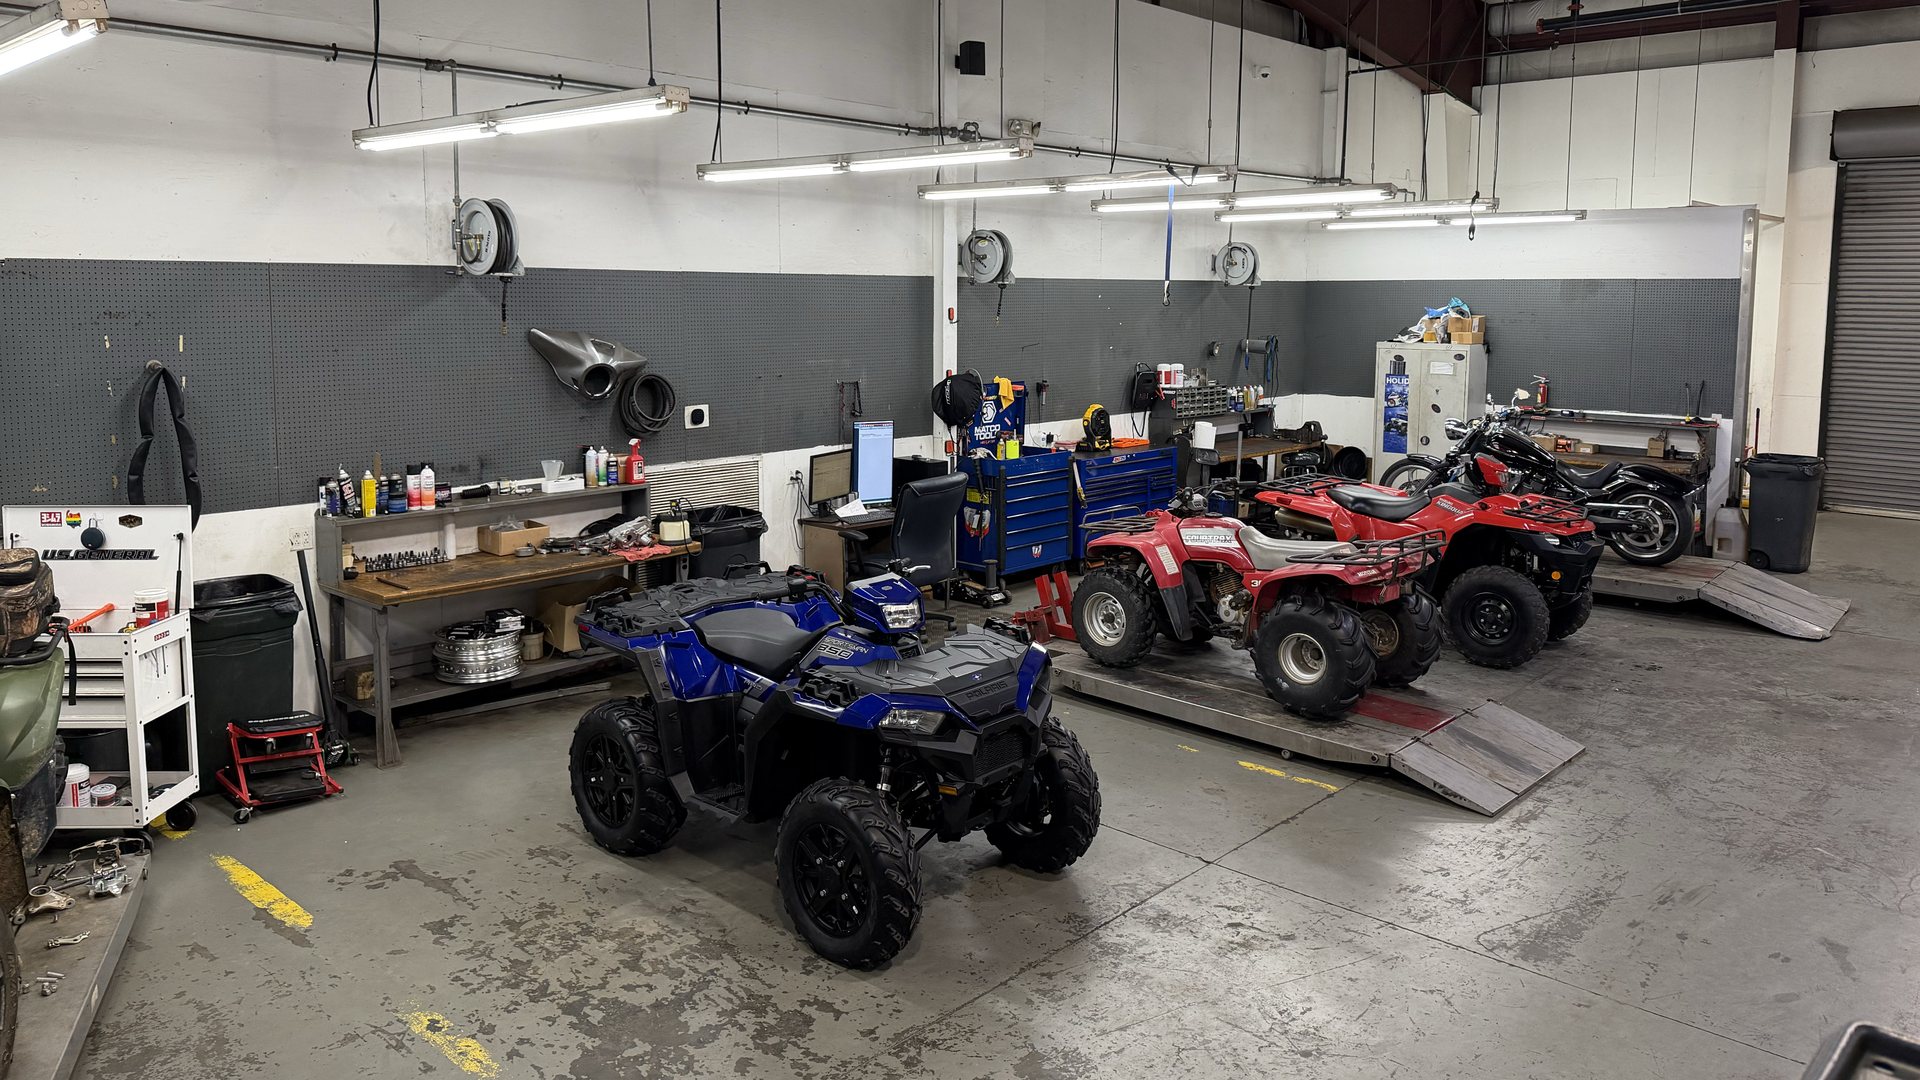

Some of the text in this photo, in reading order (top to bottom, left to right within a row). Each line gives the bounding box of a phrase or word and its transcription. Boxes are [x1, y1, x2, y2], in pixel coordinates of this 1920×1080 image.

[1386, 376, 1409, 385] HOLID
[974, 424, 1001, 434] MATCO
[1186, 534, 1233, 543] FOURTRAX
[825, 636, 869, 654] SPORTSMAN
[966, 681, 1008, 700] POLARIS
